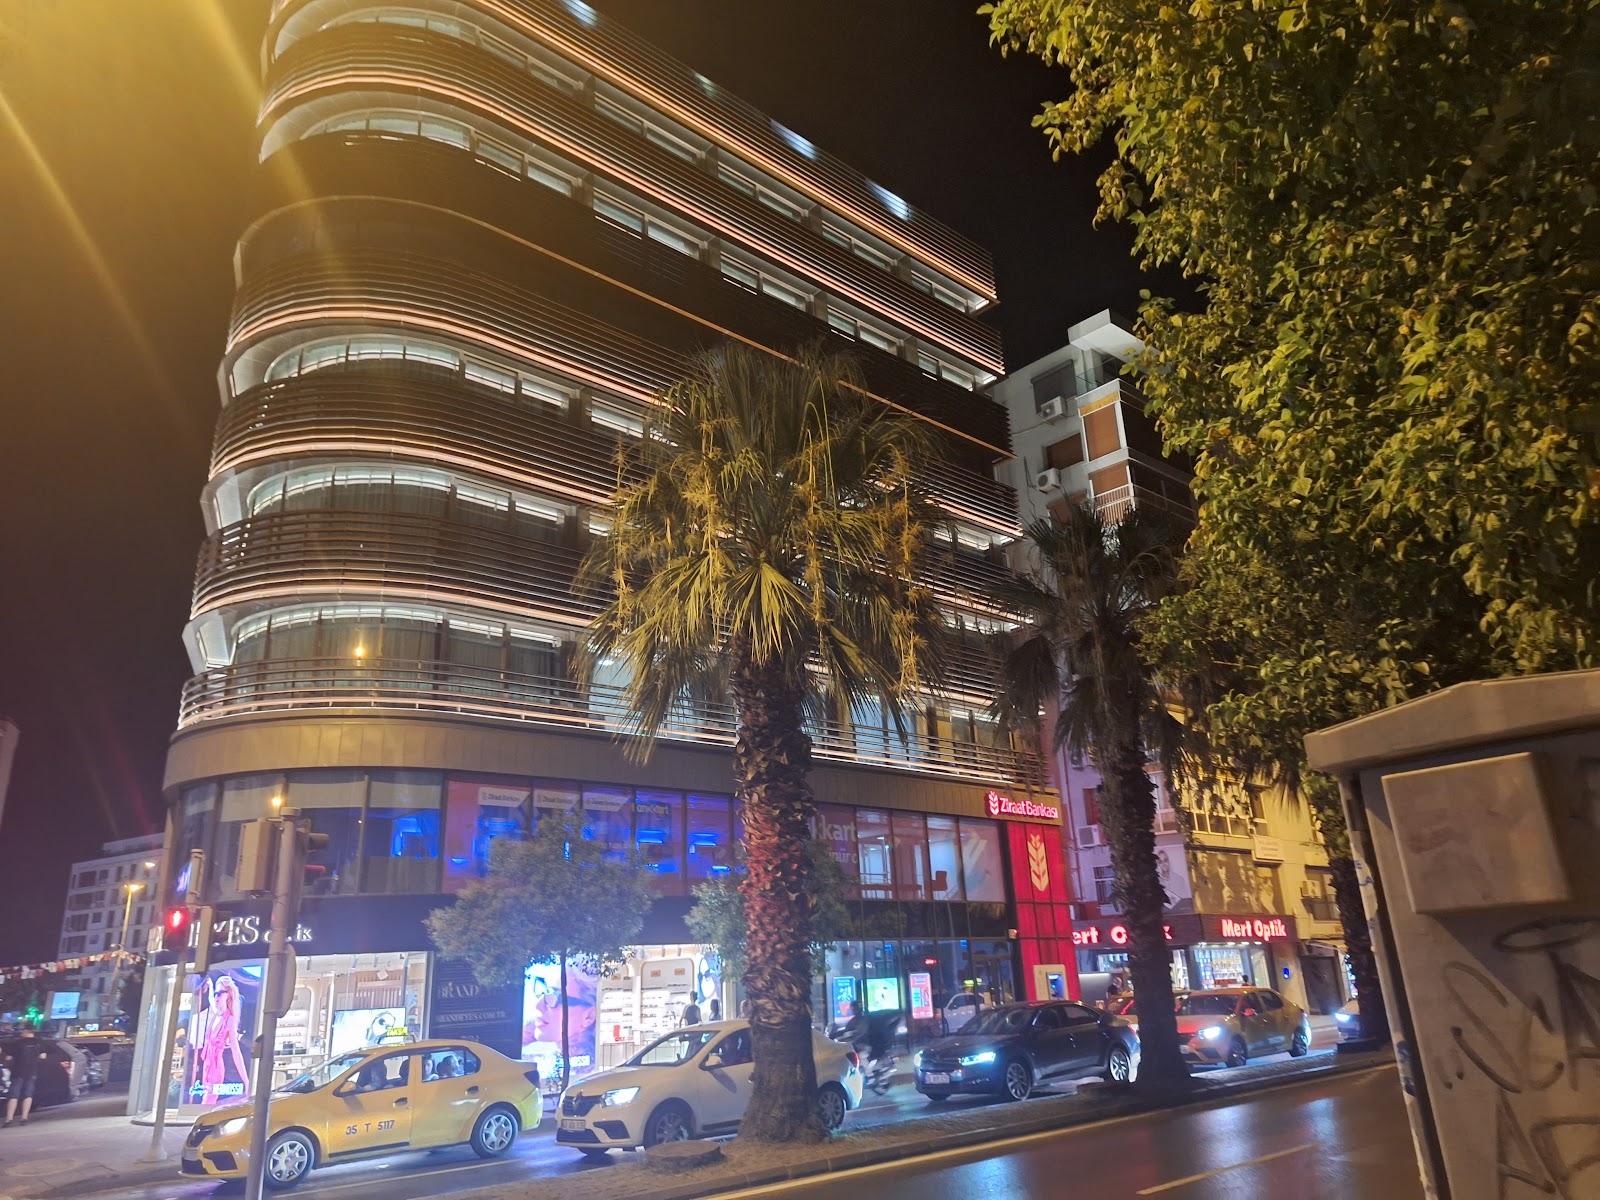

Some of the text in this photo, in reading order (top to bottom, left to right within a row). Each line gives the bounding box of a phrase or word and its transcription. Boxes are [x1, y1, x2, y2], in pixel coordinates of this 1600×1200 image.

[1000, 797, 1026, 815] Ziraat
[1072, 926, 1099, 945] ert
[1221, 918, 1287, 942] Mert Optik
[346, 1119, 396, 1136] 35 T 5117
